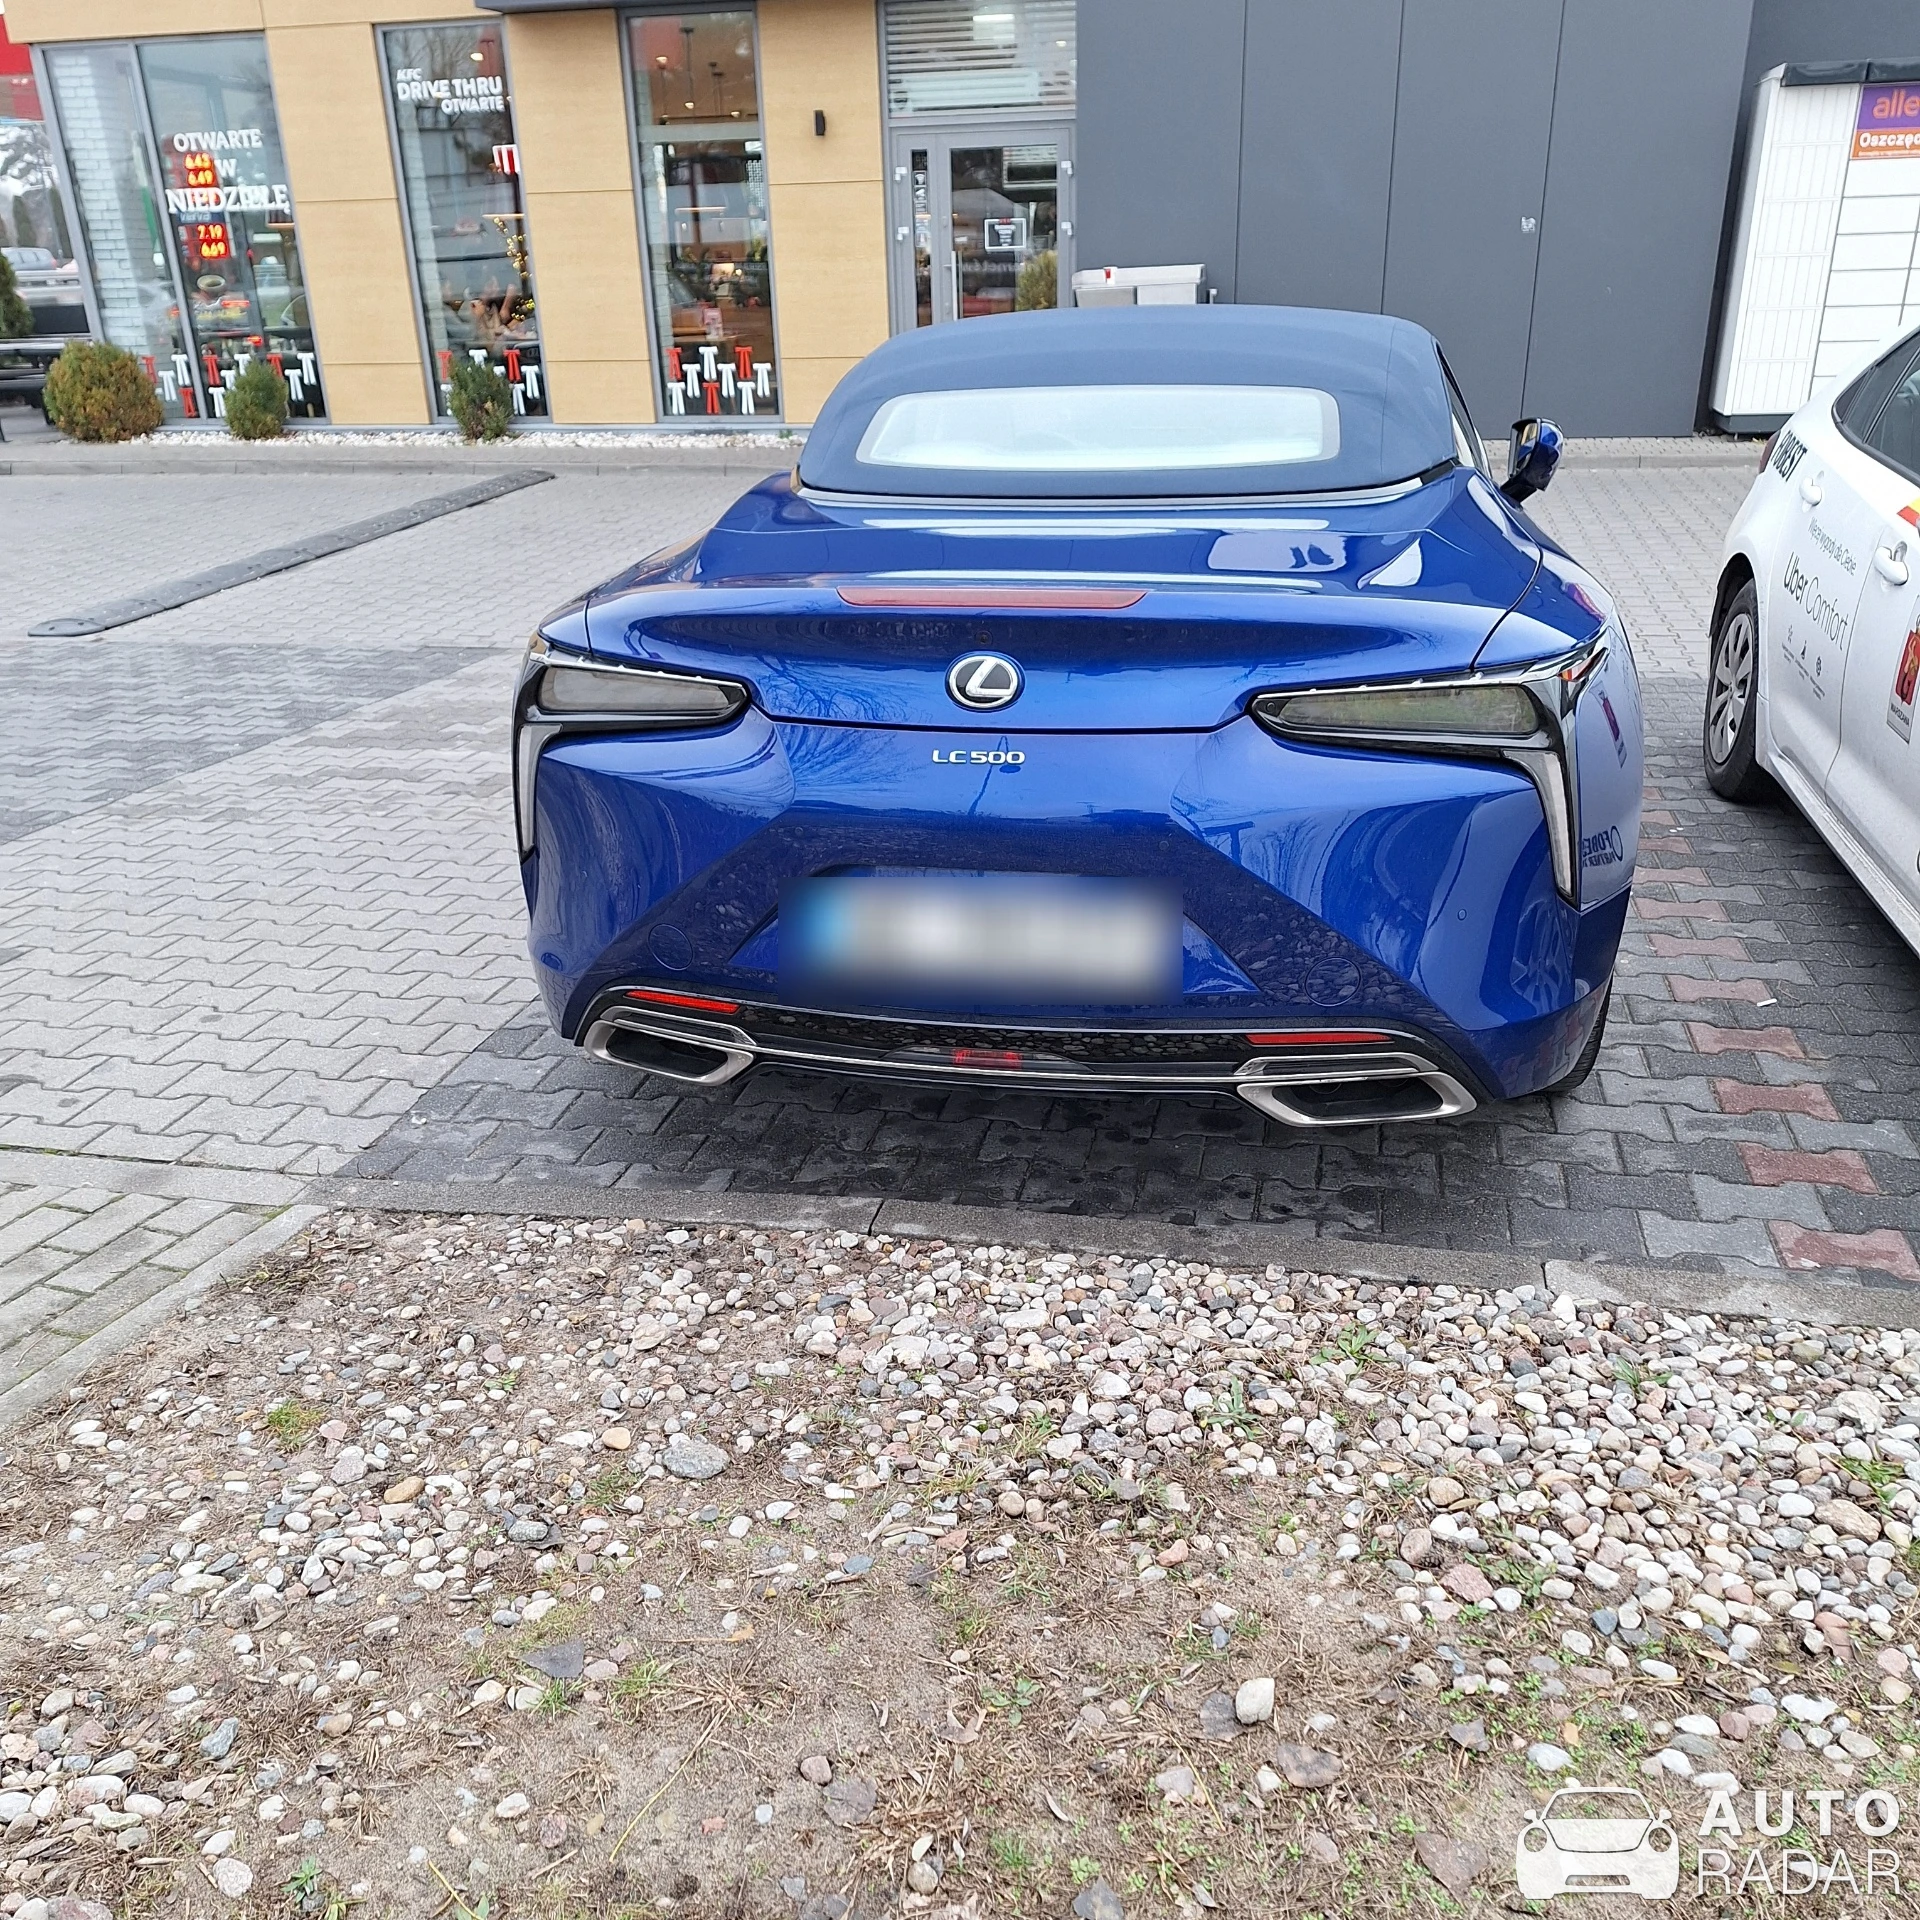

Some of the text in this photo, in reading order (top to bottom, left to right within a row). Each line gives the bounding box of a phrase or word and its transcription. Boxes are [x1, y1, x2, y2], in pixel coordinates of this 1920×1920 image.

[396, 68, 422, 80] KFC
[397, 76, 503, 101] DRIVE THRU
[441, 96, 505, 115] OTWARTE
[173, 128, 263, 152] OTWARTE
[214, 158, 237, 178] W
[1784, 551, 1808, 604] Uber
[1805, 576, 1849, 651] Comfort
[932, 749, 1026, 765] LC 500
